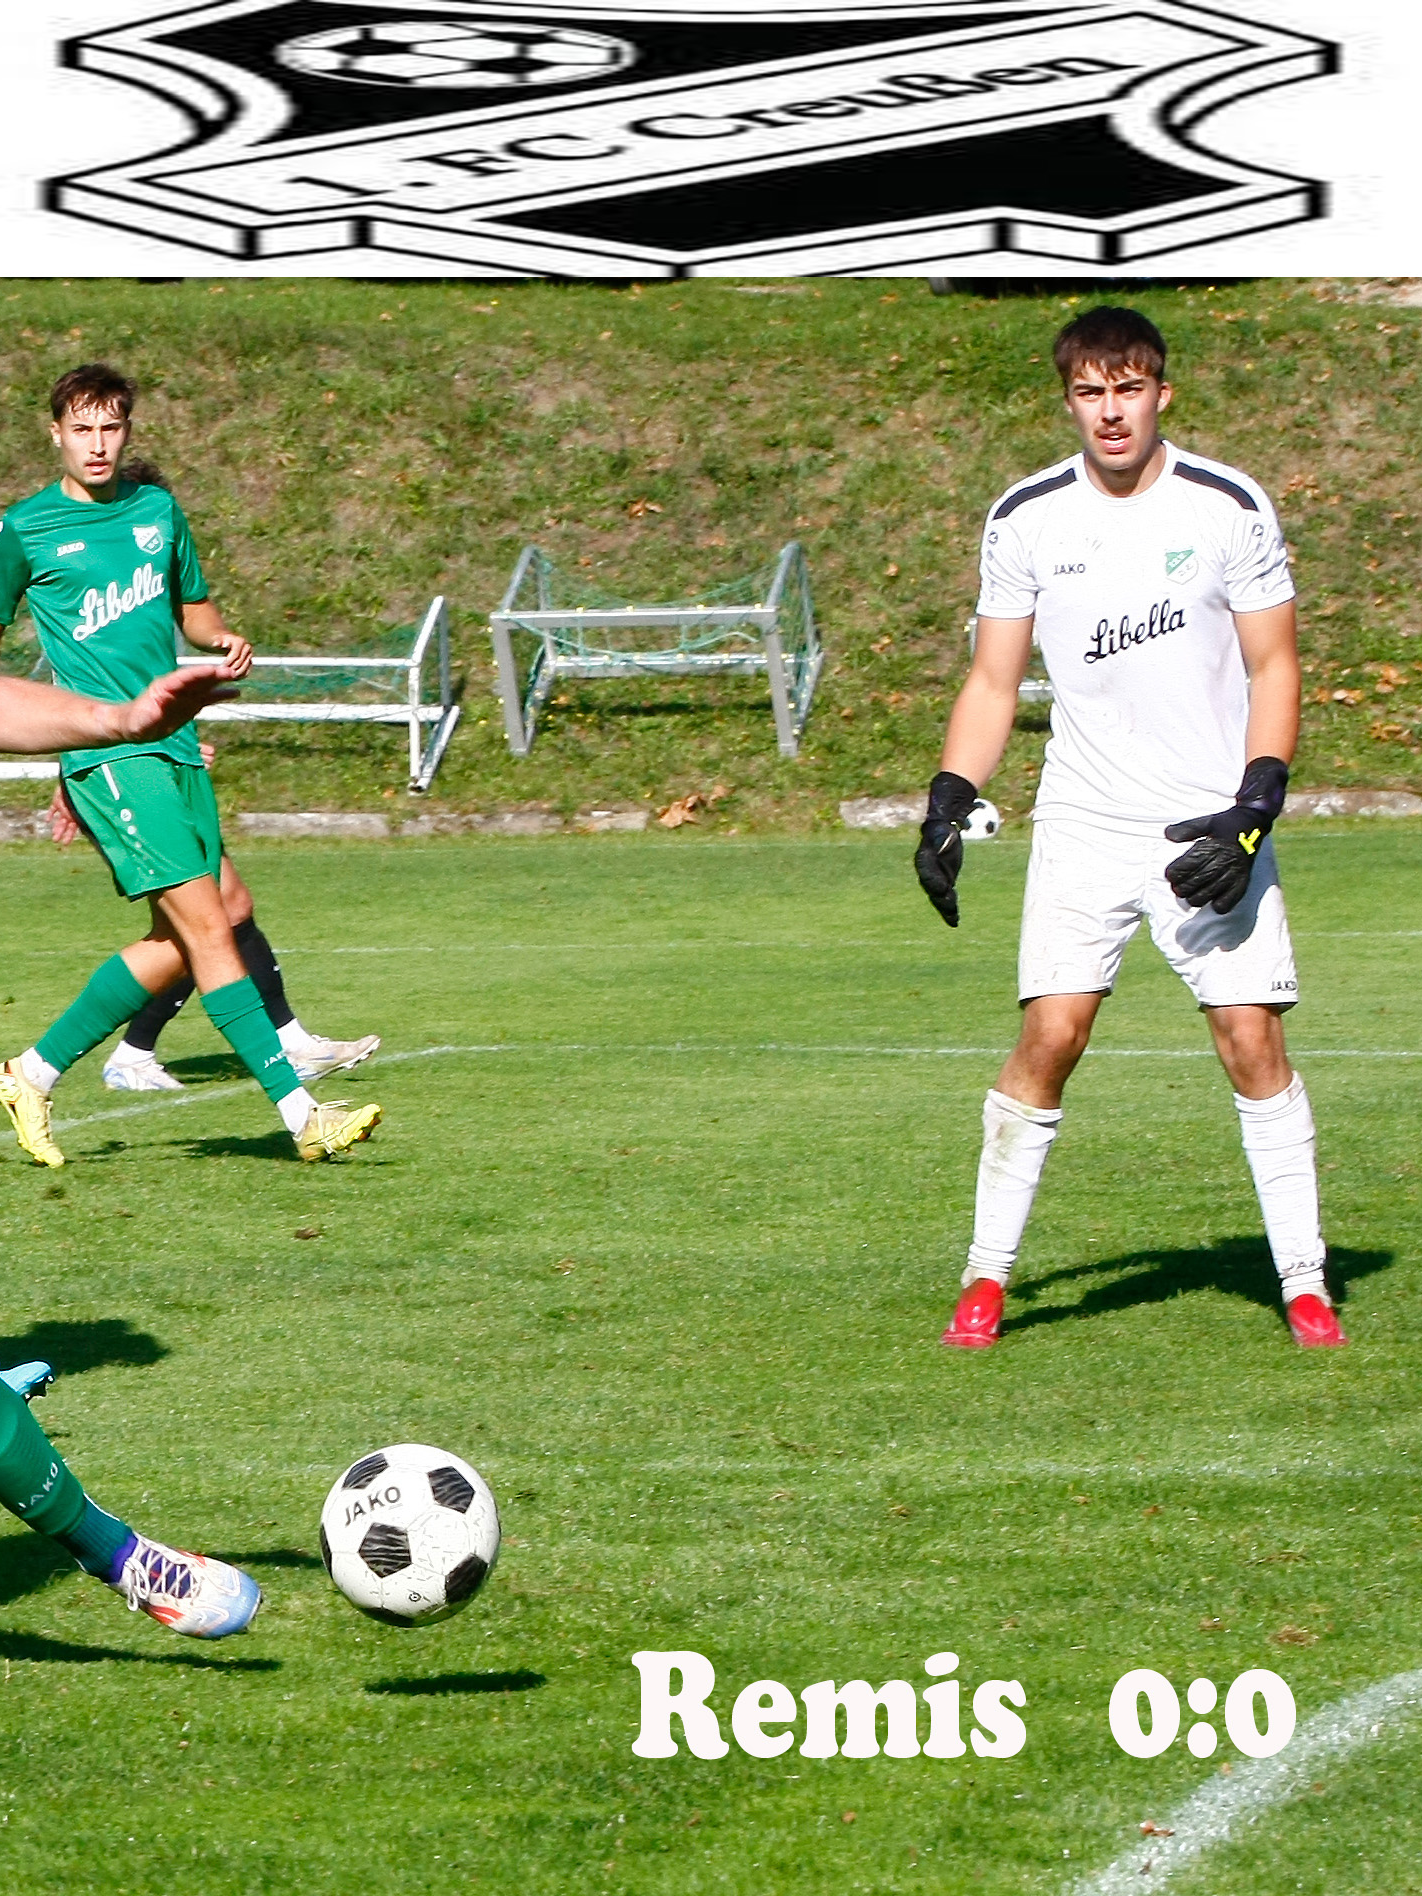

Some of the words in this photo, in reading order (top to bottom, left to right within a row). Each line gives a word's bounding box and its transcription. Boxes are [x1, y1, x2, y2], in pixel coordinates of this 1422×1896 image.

[1052, 562, 1086, 576] JAKO
[72, 562, 165, 642] Libella
[1083, 598, 1187, 664] Libella
[344, 1486, 402, 1527] JAKO
